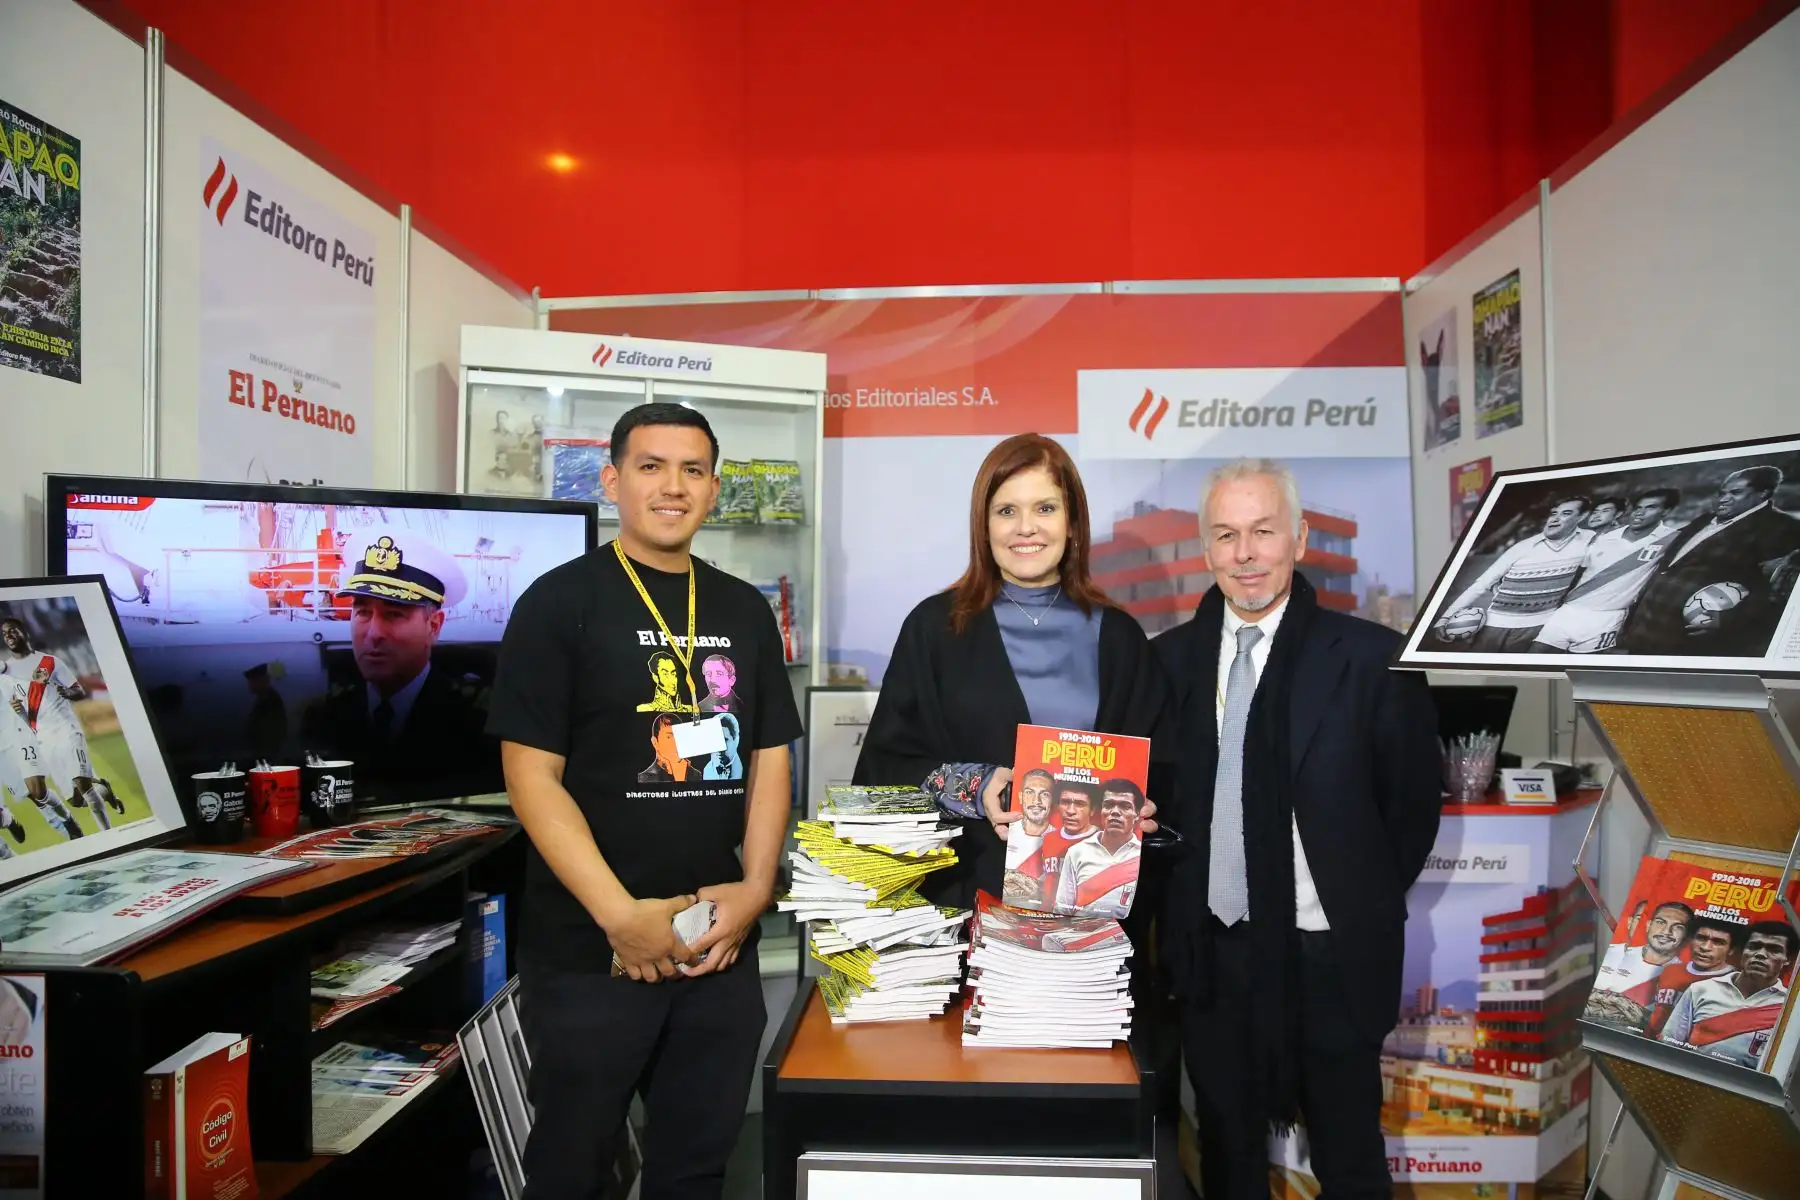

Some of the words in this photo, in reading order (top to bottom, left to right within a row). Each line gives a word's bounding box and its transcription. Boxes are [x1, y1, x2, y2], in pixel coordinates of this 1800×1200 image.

[11, 113, 42, 137] ROCHA
[244, 189, 328, 263] Editora
[331, 238, 375, 287] Perú
[9, 324, 49, 344] HISTORIA
[15, 335, 49, 351] CAMINO
[616, 350, 674, 368] Editora
[677, 355, 713, 372] Perú
[228, 368, 255, 409] El
[262, 379, 356, 435] Peruano
[856, 387, 958, 408] Editoriales
[962, 386, 999, 406] S.A.
[1177, 398, 1295, 428] Editora
[1304, 397, 1377, 427] Perú
[637, 630, 658, 646] El
[1059, 732, 1102, 745] 1930-2018
[1041, 739, 1117, 771] PERÚ
[1053, 773, 1100, 785] MUNDIALES
[1064, 766, 1075, 775] EN
[1075, 767, 1091, 776] LOS
[1518, 783, 1543, 792] VISA
[1472, 856, 1507, 870] Perú
[162, 877, 205, 894] ANDES
[1711, 872, 1761, 887] 1930-2018
[1684, 876, 1776, 912] PERÚ
[1694, 909, 1750, 925] MUNDIALES
[1708, 904, 1721, 913] EN
[1721, 907, 1741, 916] LOS
[0, 1044, 33, 1058] ano
[202, 1111, 232, 1134] Código
[209, 1130, 227, 1148] Civil
[1386, 1157, 1400, 1173] El
[1405, 1157, 1483, 1173] Peruano
